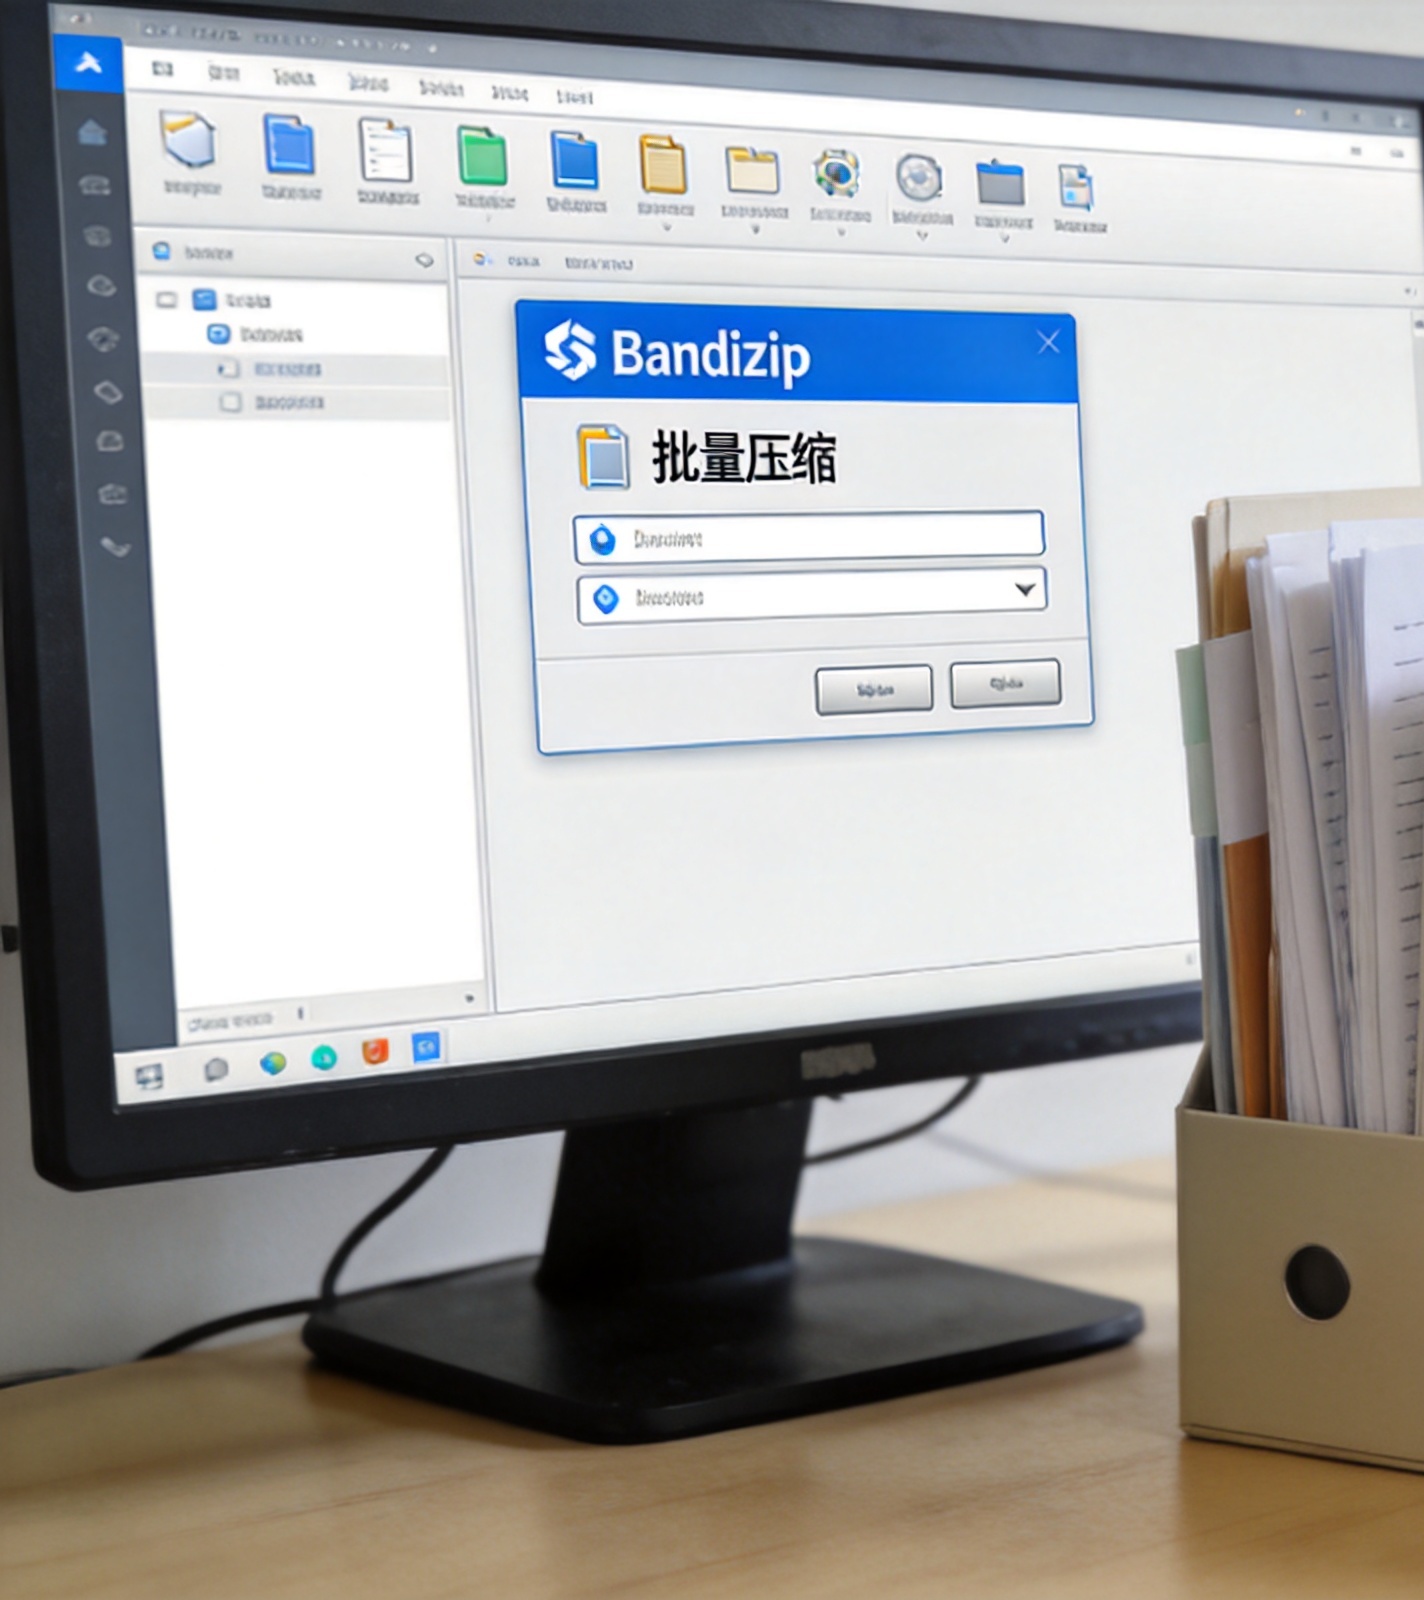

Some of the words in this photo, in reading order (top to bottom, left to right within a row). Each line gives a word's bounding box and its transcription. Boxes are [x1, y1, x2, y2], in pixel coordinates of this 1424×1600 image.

[611, 330, 811, 390] Bandizip
[652, 429, 837, 485] 批量压缩
